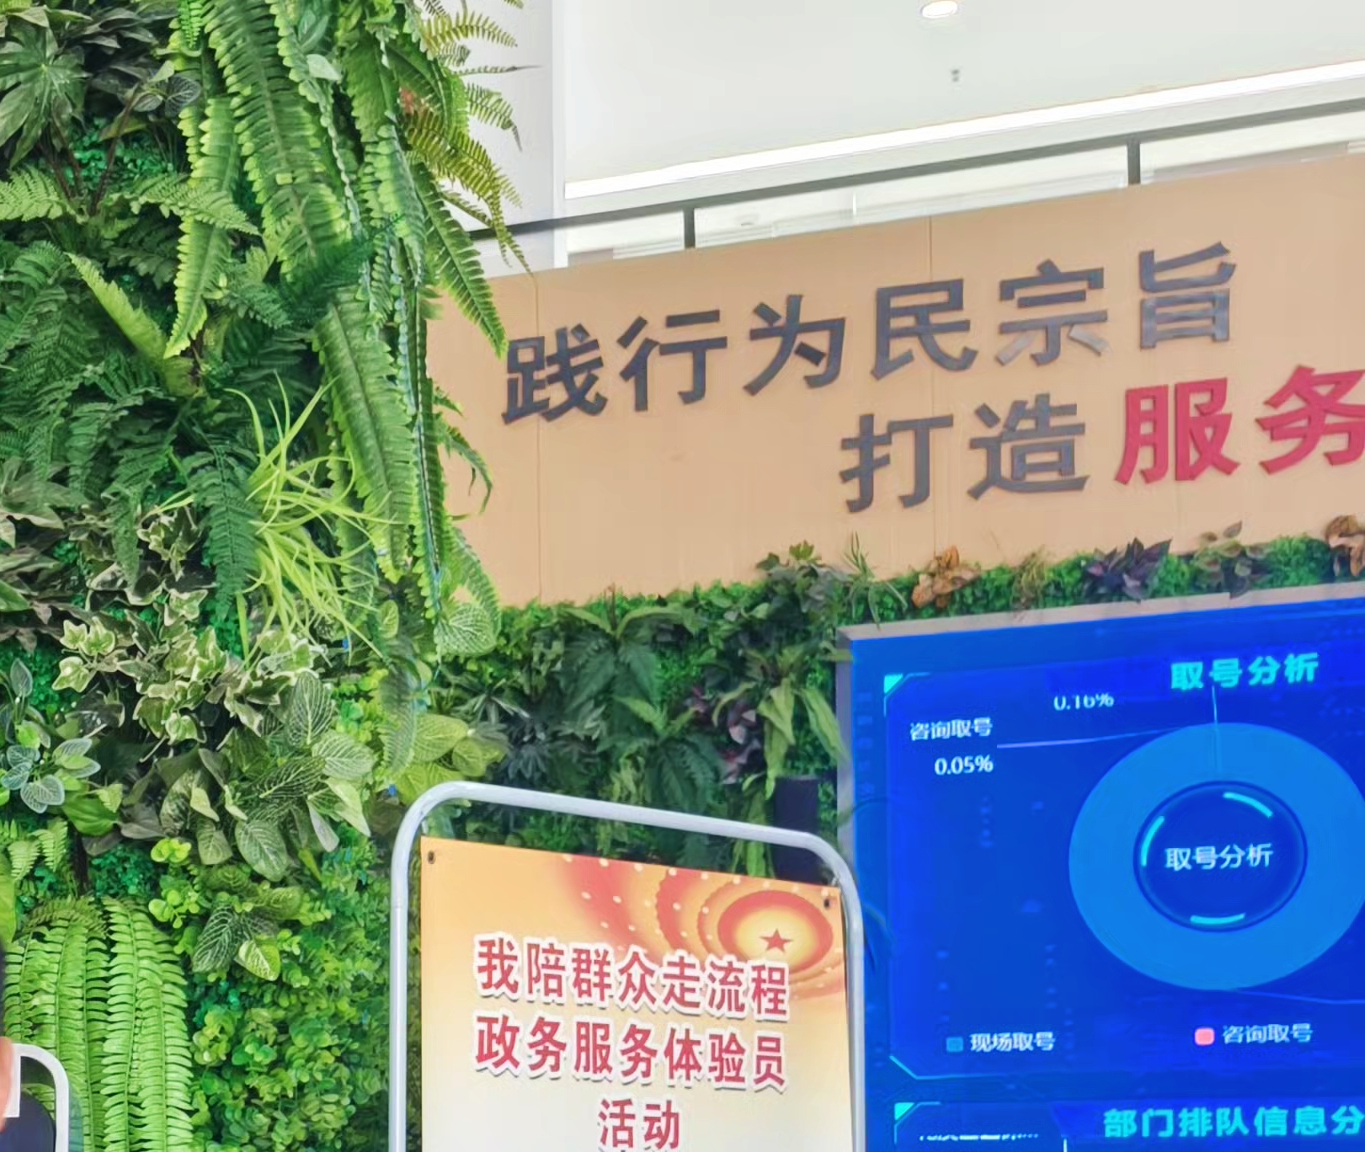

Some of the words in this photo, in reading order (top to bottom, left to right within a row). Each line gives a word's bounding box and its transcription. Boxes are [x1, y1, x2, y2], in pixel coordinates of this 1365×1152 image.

[501, 241, 1237, 426] 践行为民宗旨
[838, 363, 1365, 514] 打造服务
[1170, 652, 1320, 692] 取号分析
[909, 717, 993, 742] 咨询取号
[934, 755, 994, 777] 0.05%
[1165, 843, 1274, 871] 取号分析
[476, 935, 789, 1017] 我陪群众走流程
[475, 1013, 787, 1088] 政务服务体验员
[970, 1031, 1056, 1053] 现场取号
[1222, 1023, 1314, 1045] 咨询取号
[598, 1098, 681, 1151] 活动
[1103, 1105, 1365, 1139] 部门排队信息分
